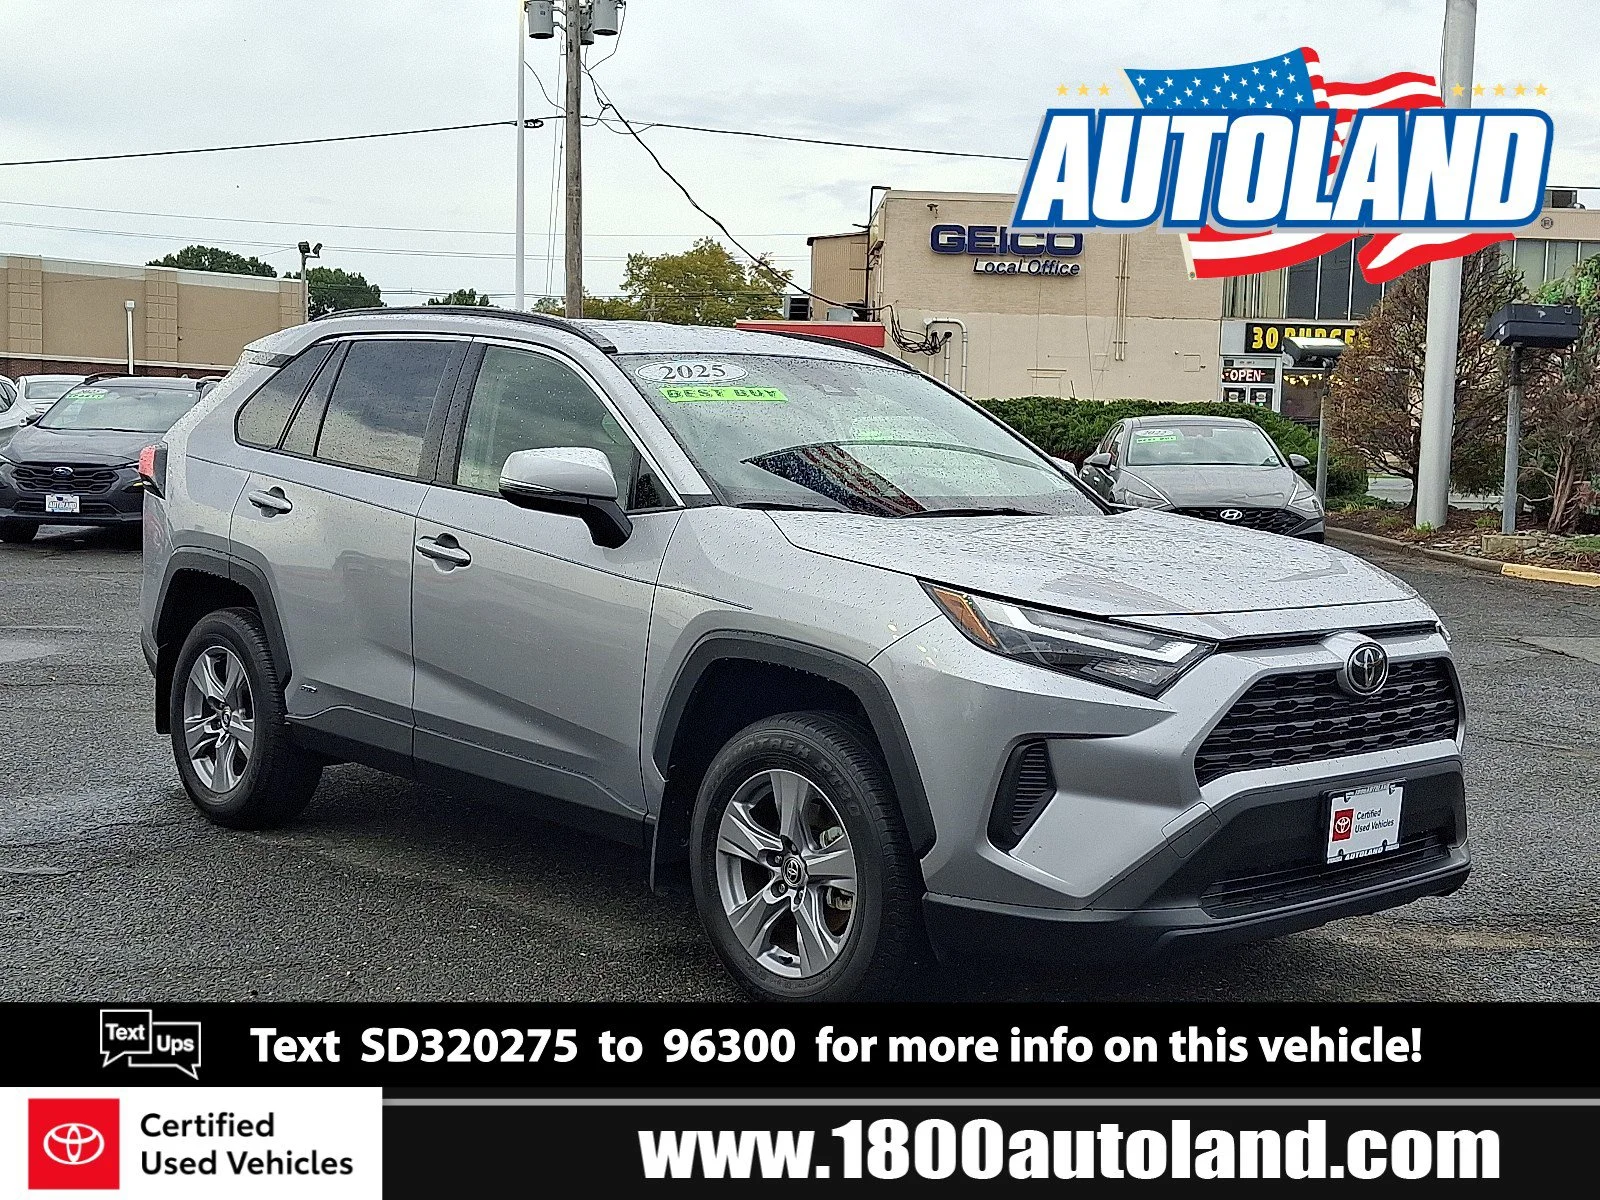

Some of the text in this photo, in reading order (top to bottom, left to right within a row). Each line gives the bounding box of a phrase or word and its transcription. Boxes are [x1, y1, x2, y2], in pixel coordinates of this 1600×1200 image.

[930, 224, 1084, 256] GEICO
[973, 258, 1081, 275] Local Office
[1252, 326, 1279, 350] 30
[659, 364, 726, 380] 2025
[1230, 369, 1262, 382] OPEN
[666, 388, 777, 398] BEST BUY
[1356, 807, 1382, 821] Certified
[1354, 818, 1395, 834] Used Vehicles
[1344, 846, 1384, 861] AUTOLAND
